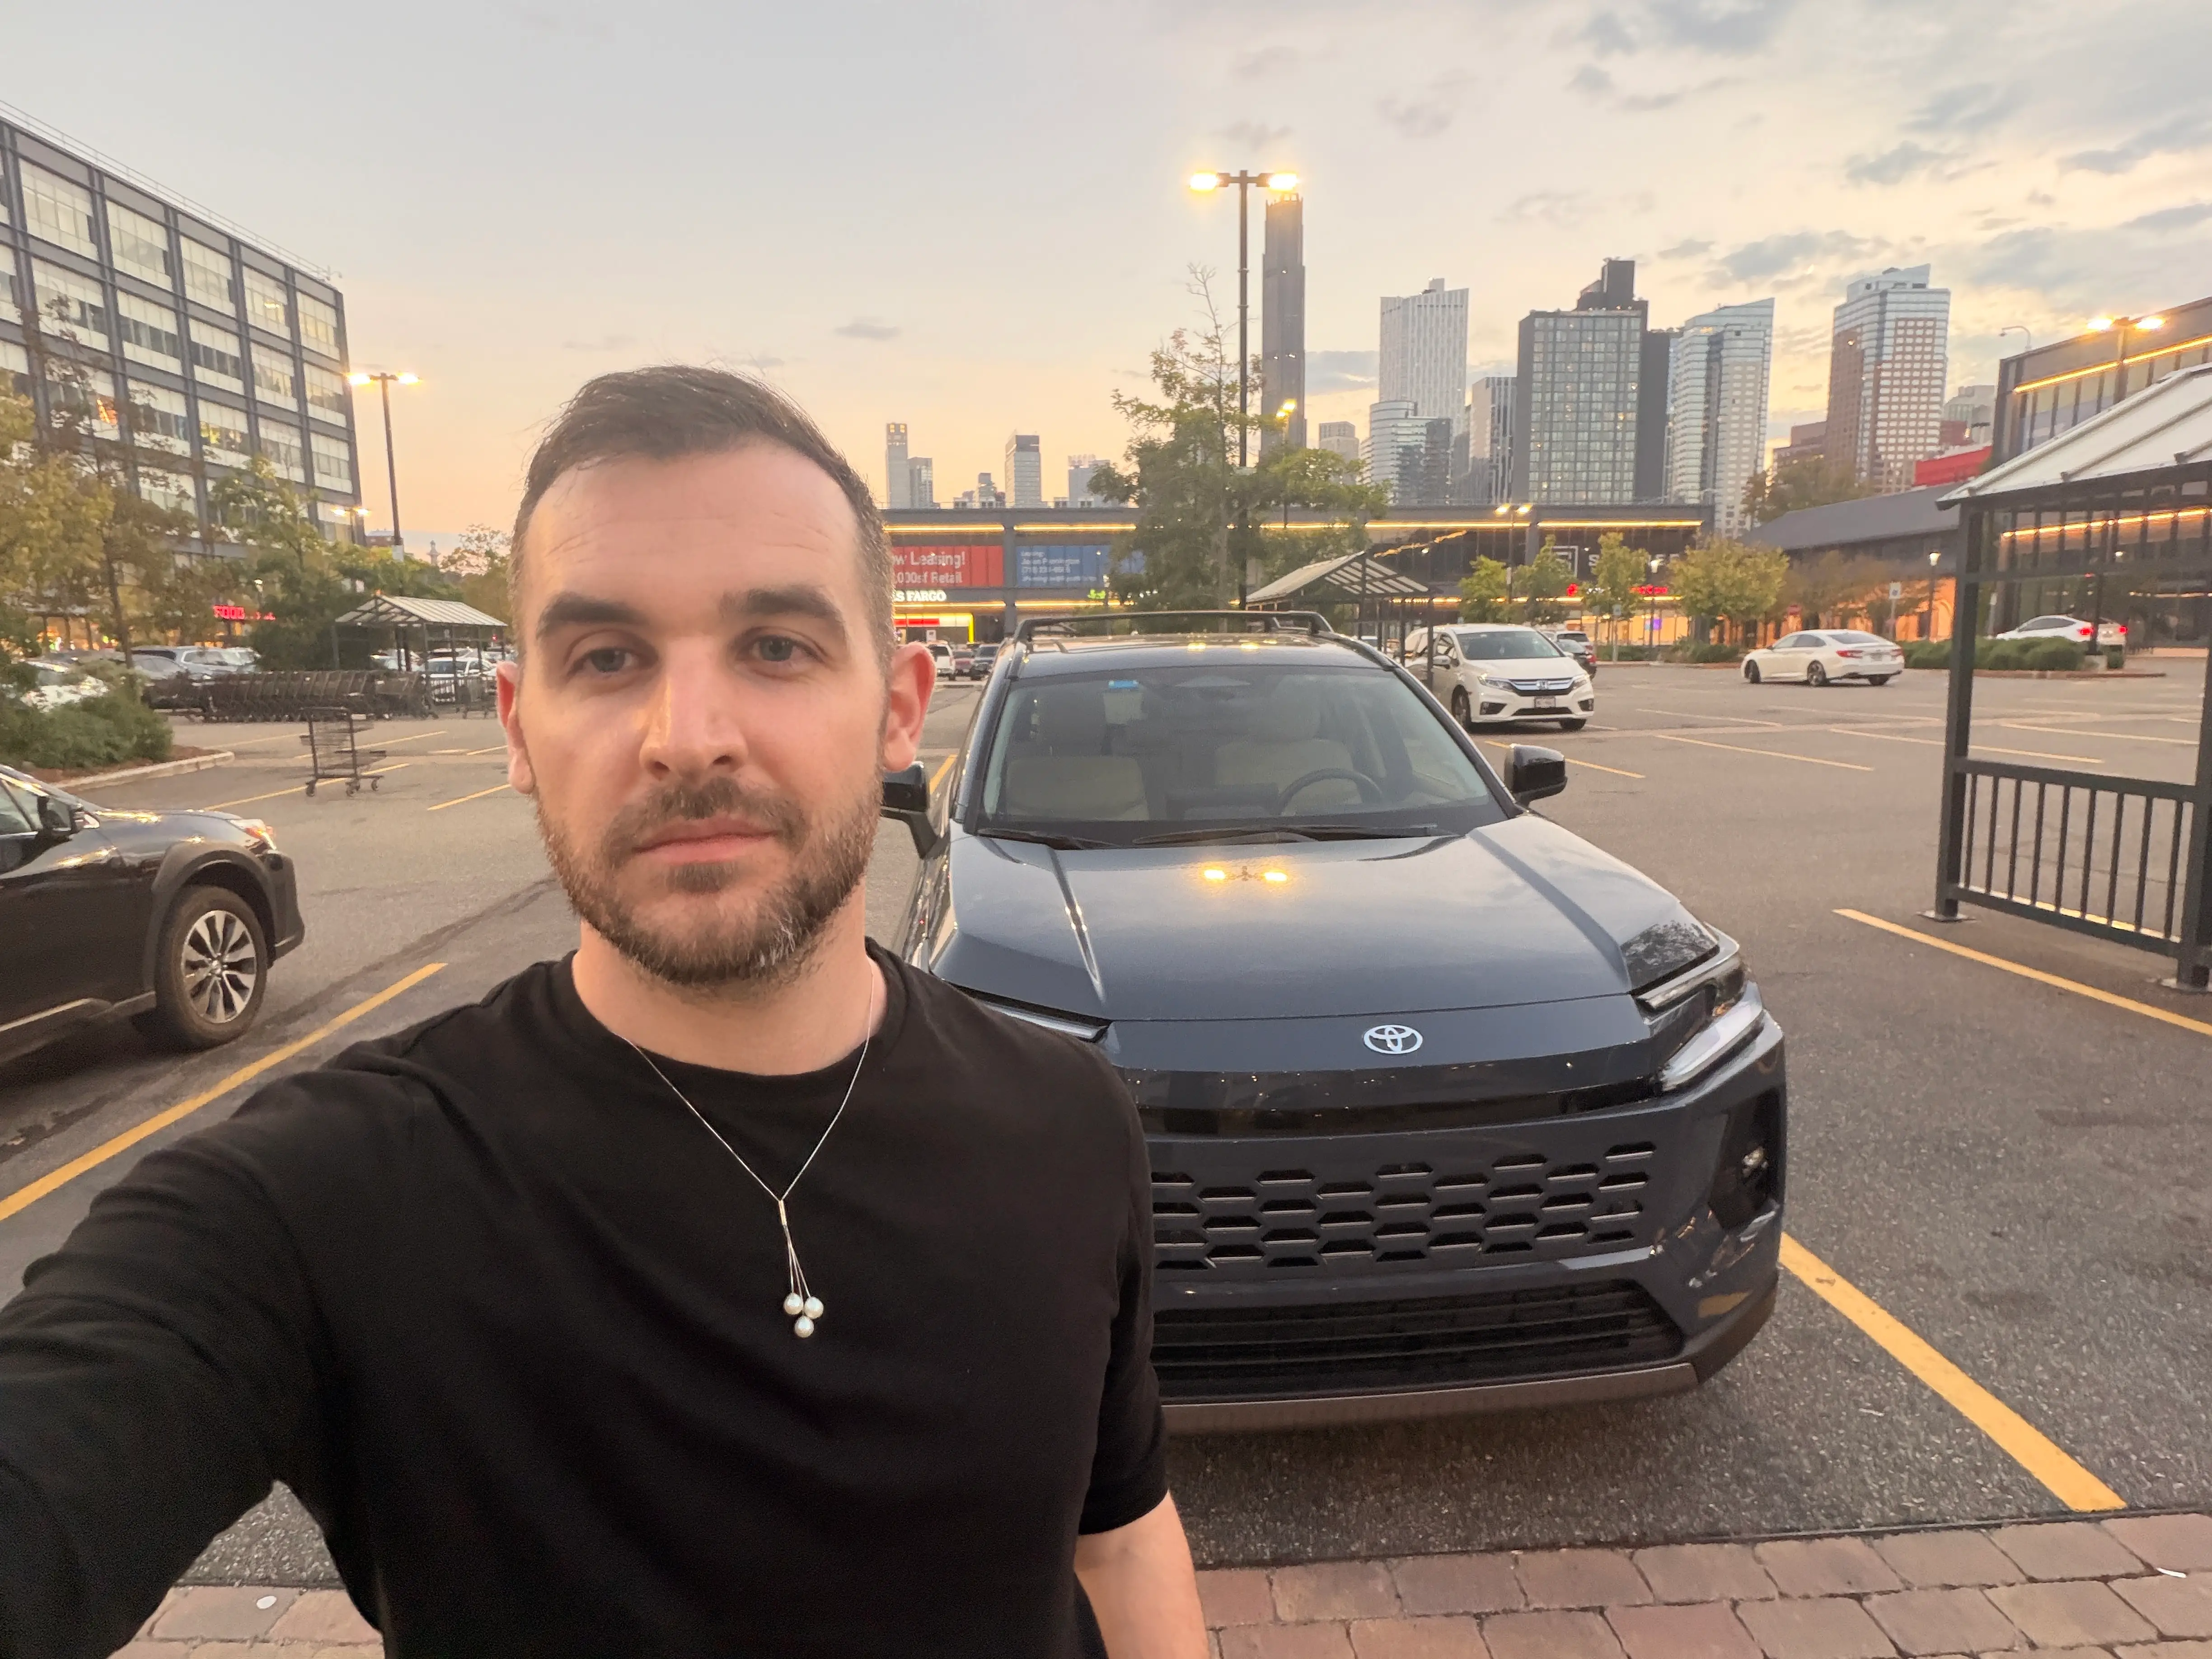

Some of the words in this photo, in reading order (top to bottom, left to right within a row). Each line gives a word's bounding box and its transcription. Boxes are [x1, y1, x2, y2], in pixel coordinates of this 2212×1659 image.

[910, 551, 965, 569] Leasing!
[931, 572, 963, 583] Retail
[906, 590, 947, 602] FARGO
